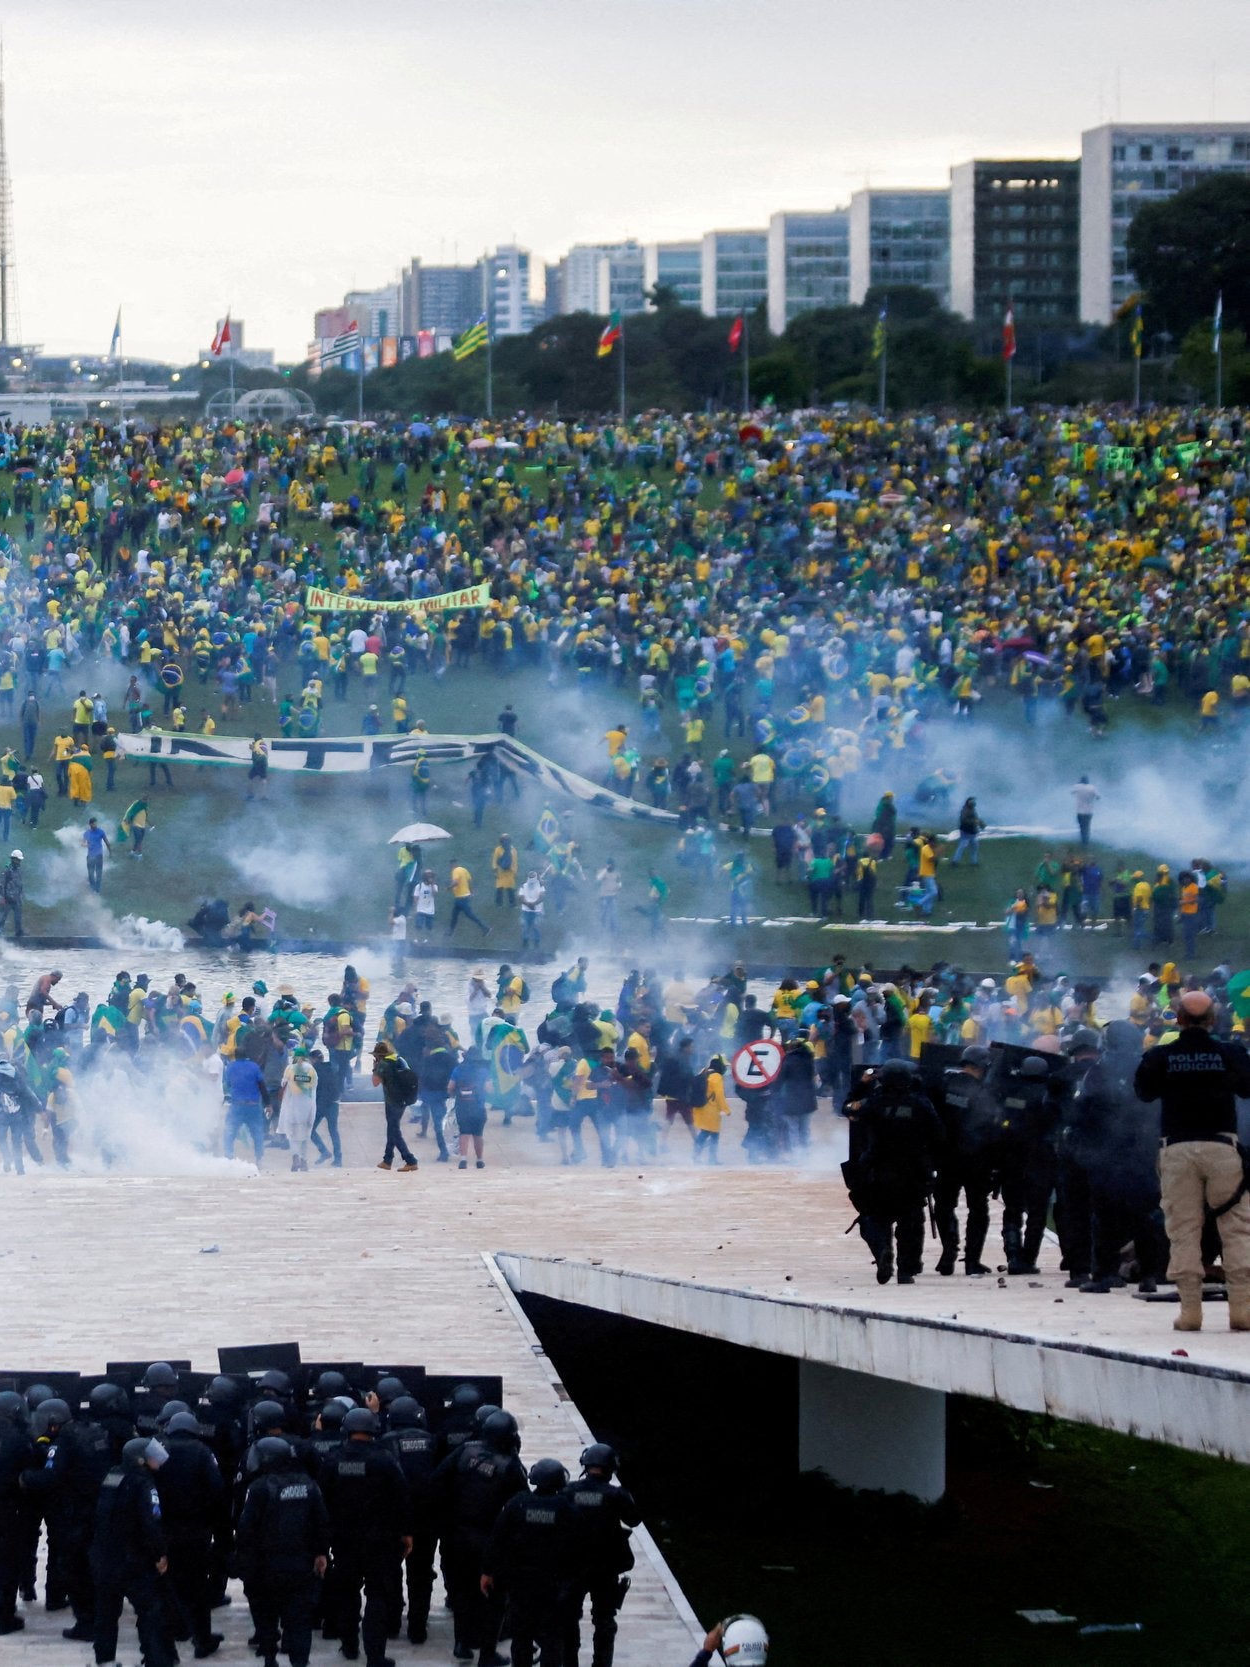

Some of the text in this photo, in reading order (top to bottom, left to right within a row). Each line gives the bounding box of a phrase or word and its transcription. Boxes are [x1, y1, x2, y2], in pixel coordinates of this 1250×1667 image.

[419, 589, 481, 611] MILITAR
[747, 1050, 770, 1076] E
[1166, 1062, 1226, 1073] JUDICIAL
[280, 1484, 308, 1501] CHOQUE
